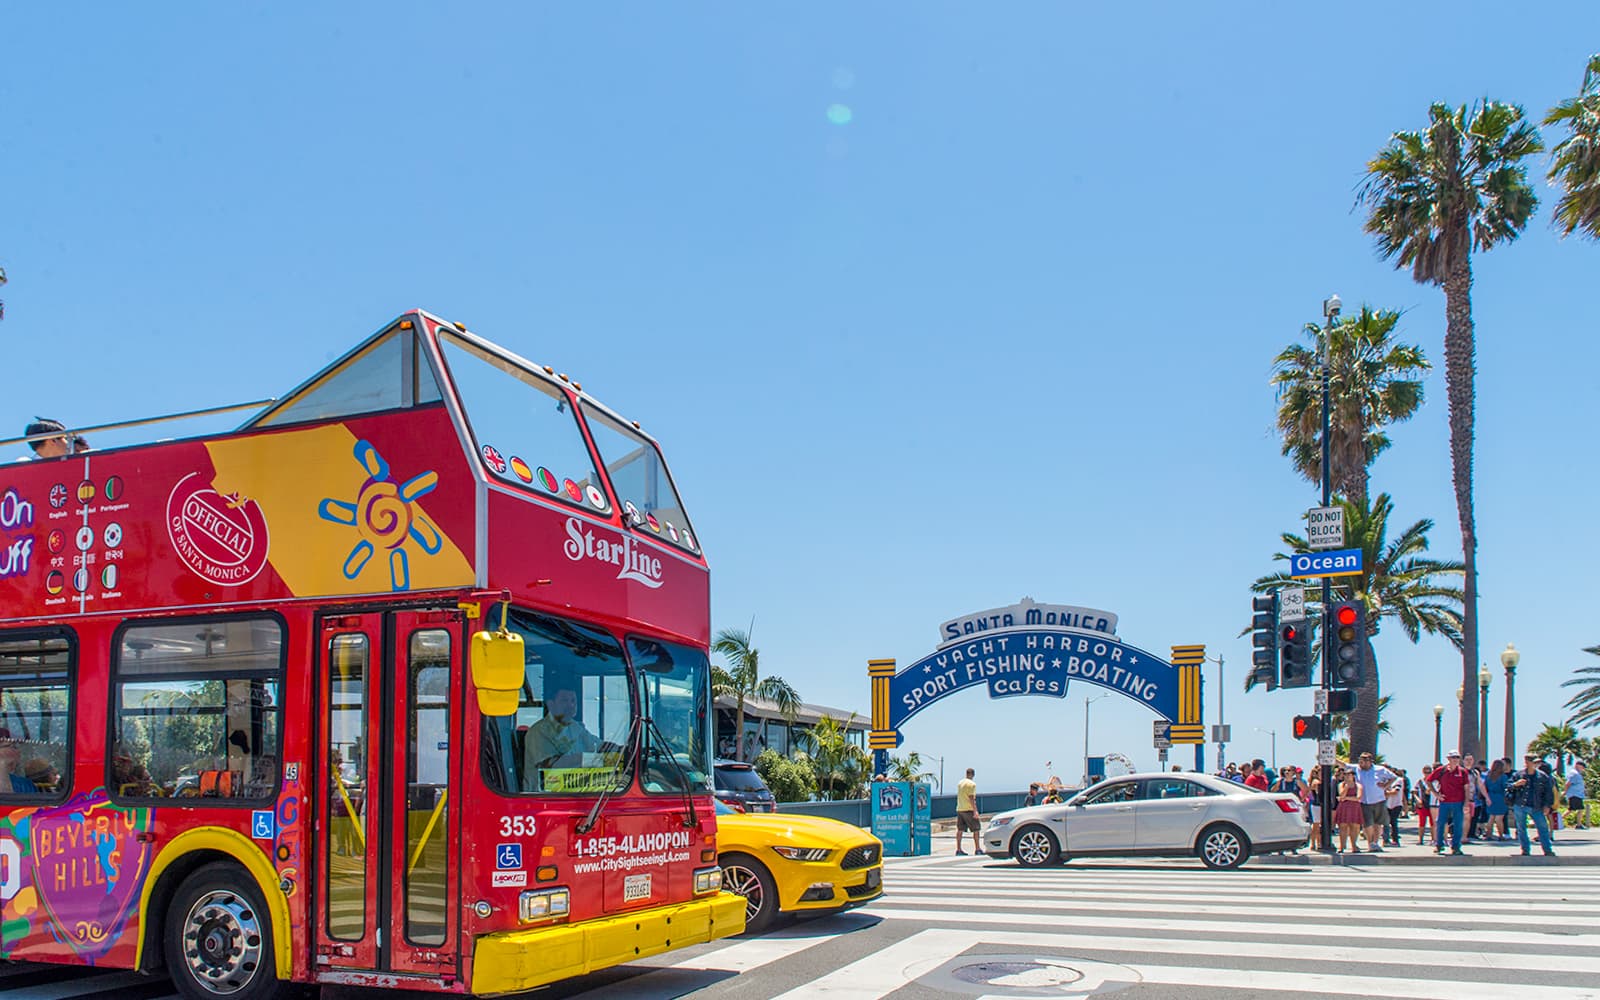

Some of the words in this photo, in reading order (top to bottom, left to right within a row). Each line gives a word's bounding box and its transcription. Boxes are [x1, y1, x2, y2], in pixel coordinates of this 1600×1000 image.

[1, 491, 33, 527] On
[1311, 513, 1323, 523] DO
[1325, 511, 1341, 522] NOT
[172, 516, 183, 533] OF
[187, 501, 248, 555] OFFICIAL
[1311, 525, 1341, 536] BLOCK
[1311, 537, 1341, 545] INTERSECTION
[177, 535, 203, 570] SANTA
[1297, 555, 1357, 571] Ocean
[204, 564, 250, 580] MONICA
[1282, 608, 1303, 617] SIGNAL
[946, 613, 1013, 640] SANTA
[1026, 608, 1108, 633] MONICA
[936, 638, 1009, 668] YACHT
[1026, 636, 1123, 662] HARBOR
[902, 669, 957, 711] SPORT
[966, 654, 1045, 681] FISHING
[1067, 656, 1158, 701] BOATING
[286, 767, 297, 777] 45
[563, 772, 591, 789] YELLOW
[499, 815, 536, 837] 353
[575, 831, 690, 859] 1-855-4LAHOPON
[55, 850, 121, 892] HILLS
[574, 851, 690, 874] www.CitySightseeingLA.com
